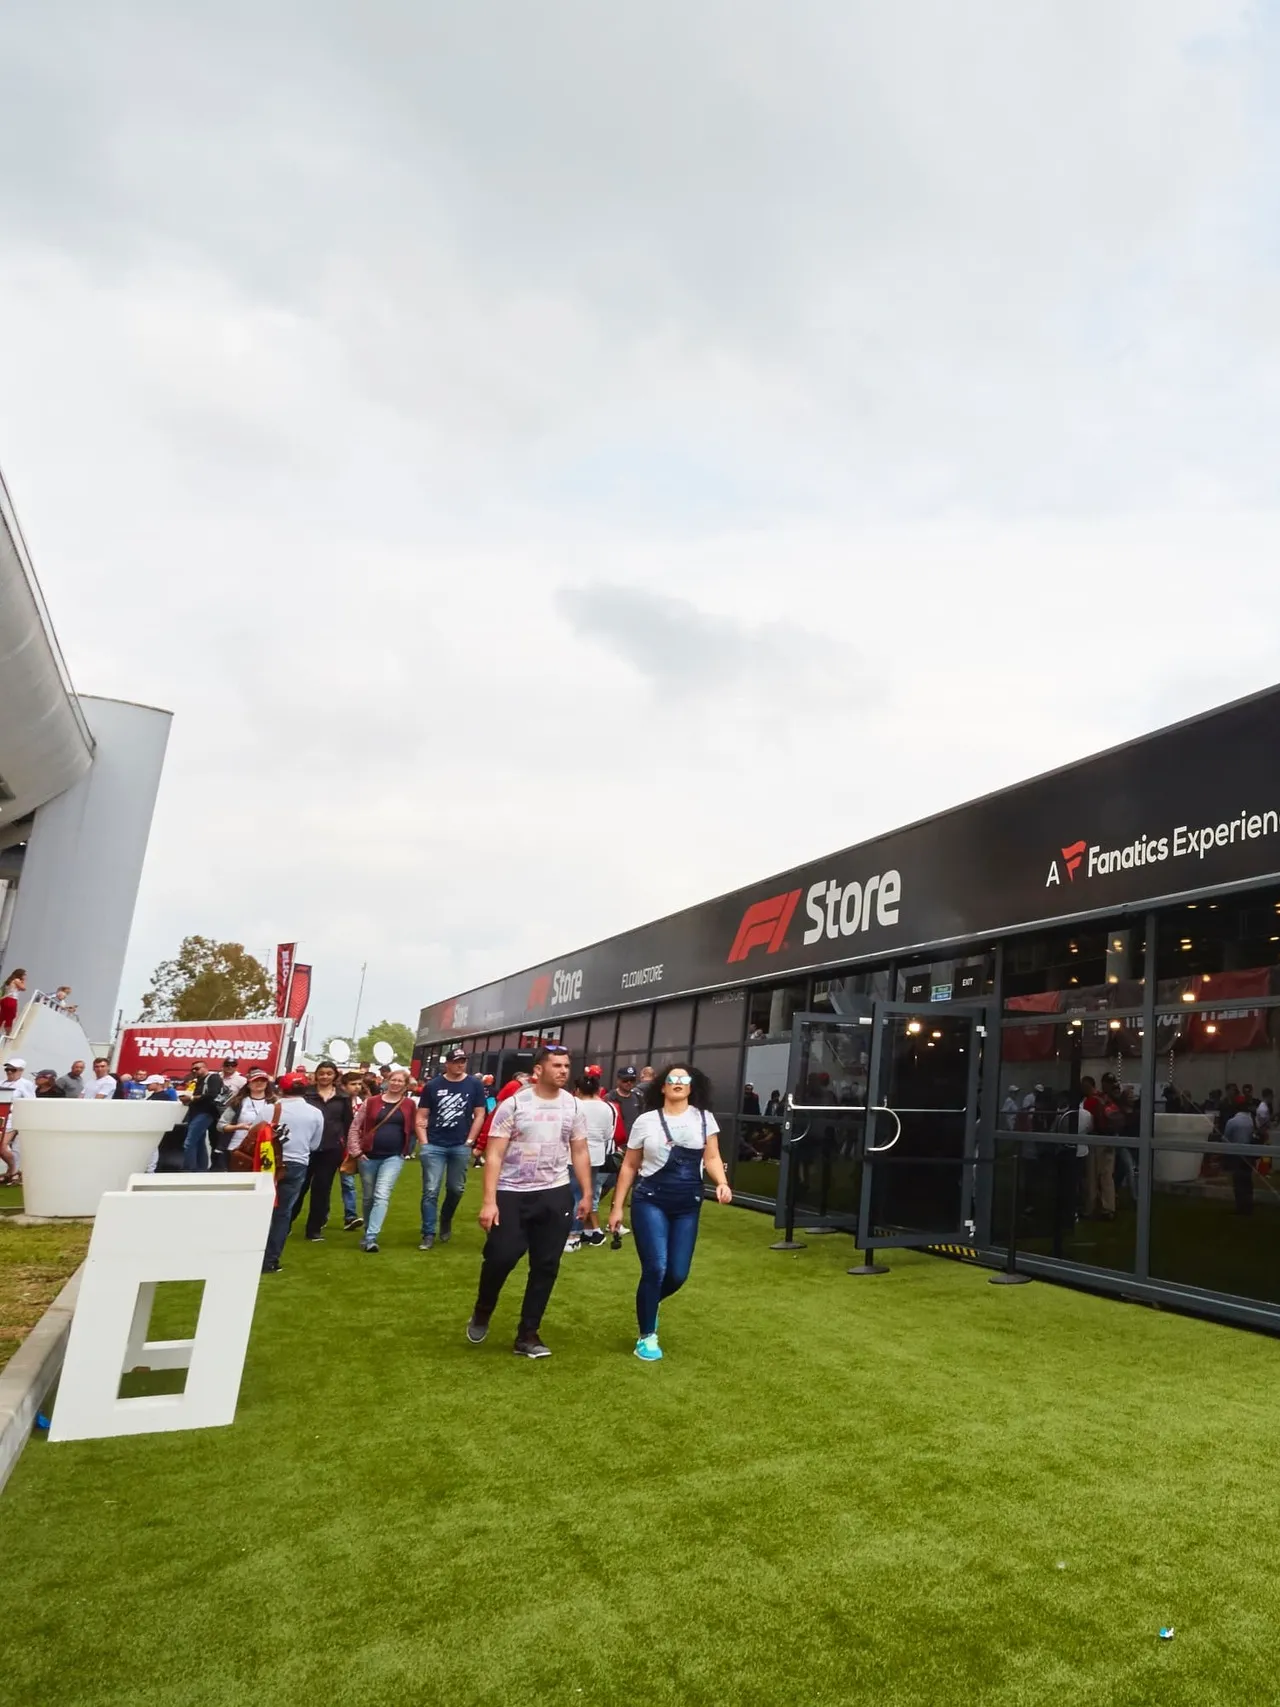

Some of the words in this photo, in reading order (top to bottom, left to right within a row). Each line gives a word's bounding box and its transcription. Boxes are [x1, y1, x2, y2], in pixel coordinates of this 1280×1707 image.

[1045, 861, 1060, 887] A
[1088, 834, 1168, 877] Fanatics
[803, 869, 901, 946] Store
[551, 969, 583, 1006] Store
[962, 977, 974, 987] EXIT
[912, 985, 923, 994] EXIT
[134, 1037, 170, 1048] THE
[171, 1038, 231, 1050] GRAND
[232, 1040, 272, 1051] PRIX
[138, 1047, 159, 1057] IN
[160, 1047, 208, 1058] YOUR
[210, 1049, 269, 1060] HANDS
